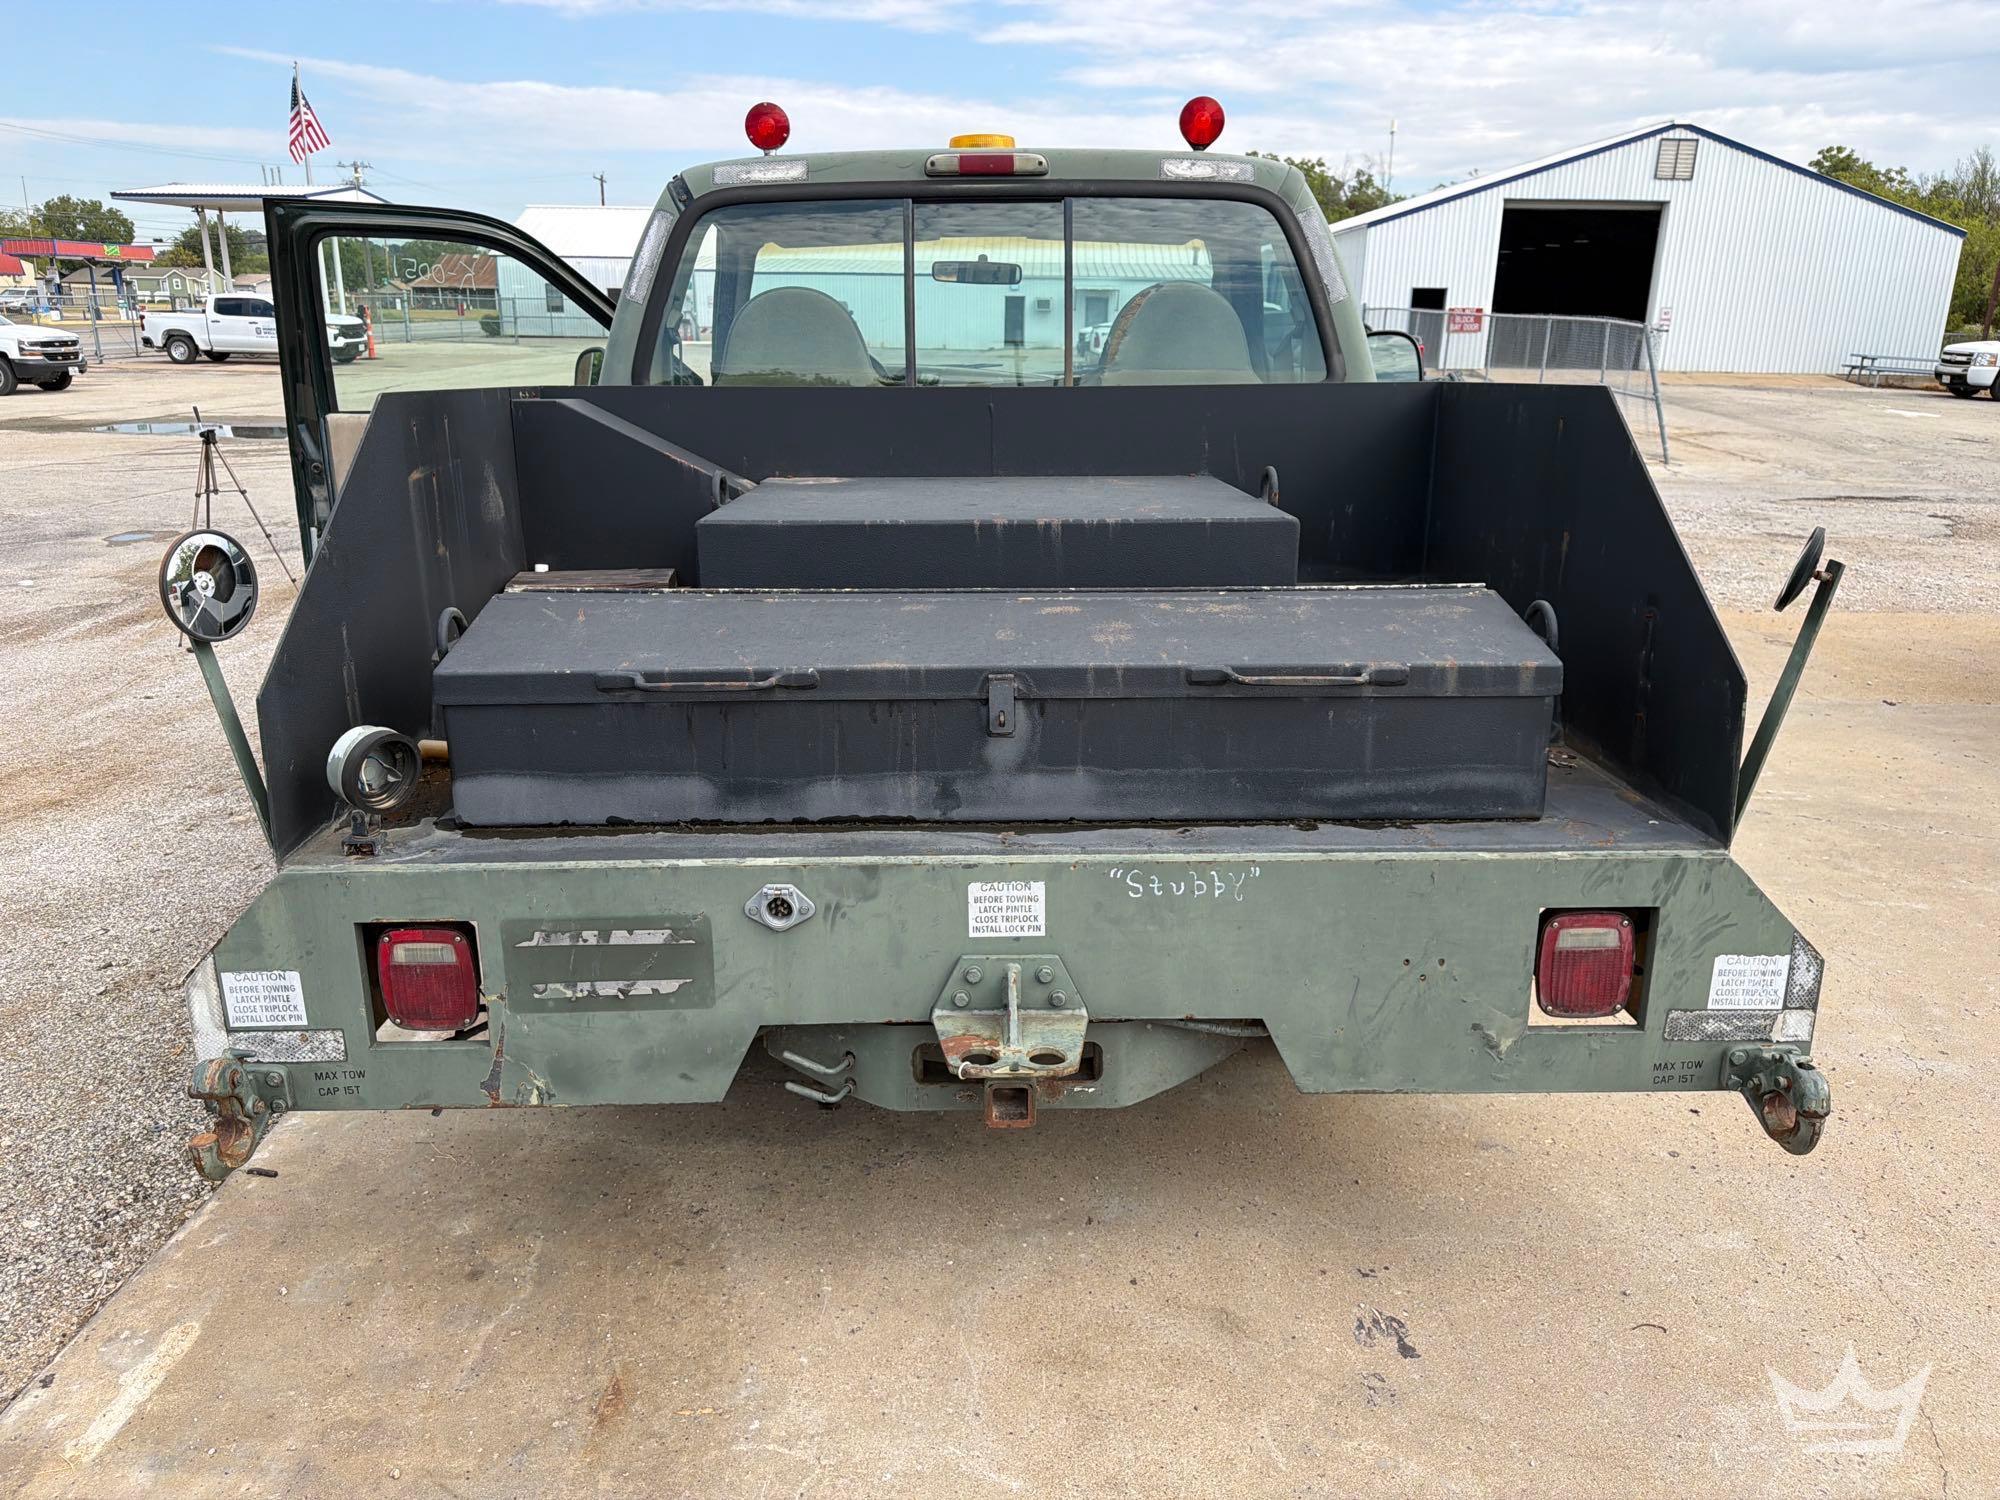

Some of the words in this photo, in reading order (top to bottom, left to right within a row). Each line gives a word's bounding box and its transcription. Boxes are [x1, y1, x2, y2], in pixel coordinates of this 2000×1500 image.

[1455, 315, 1475, 324] BLOCK
[1463, 323, 1480, 331] DOOR
[980, 883, 1032, 892] CAUTION
[973, 896, 1003, 904] BEFORE
[1006, 895, 1040, 903] TOWING
[1006, 905, 1032, 913] PINTLE
[1001, 915, 1039, 923] TRIPLOCK
[1005, 925, 1025, 933] LOCK
[1726, 957, 1777, 966] CAUTION
[234, 973, 286, 982] CAUTION
[1718, 969, 1747, 977] BEFORE
[1750, 969, 1782, 977] TOWING
[229, 986, 259, 994] BEFORE
[262, 985, 296, 993] TOWING
[236, 996, 260, 1004] LATCH
[263, 995, 291, 1003] PINTLE
[1711, 998, 1740, 1006] INSTALL
[1743, 998, 1762, 1006] LOCK
[233, 1006, 257, 1014] CLOSE
[260, 1004, 299, 1013] TRIPLOCK
[232, 1015, 264, 1024] INSTALL
[266, 1014, 287, 1022] LOCK
[289, 1014, 303, 1022] PIN
[1653, 1062, 1676, 1071] MAX
[1680, 1060, 1704, 1070] TOW
[314, 1071, 338, 1080] MAX
[341, 1070, 366, 1079] TOW
[1653, 1075, 1675, 1085] CAP
[1678, 1074, 1696, 1083] 15T
[318, 1087, 340, 1096] CAP
[343, 1085, 360, 1095] 15T
